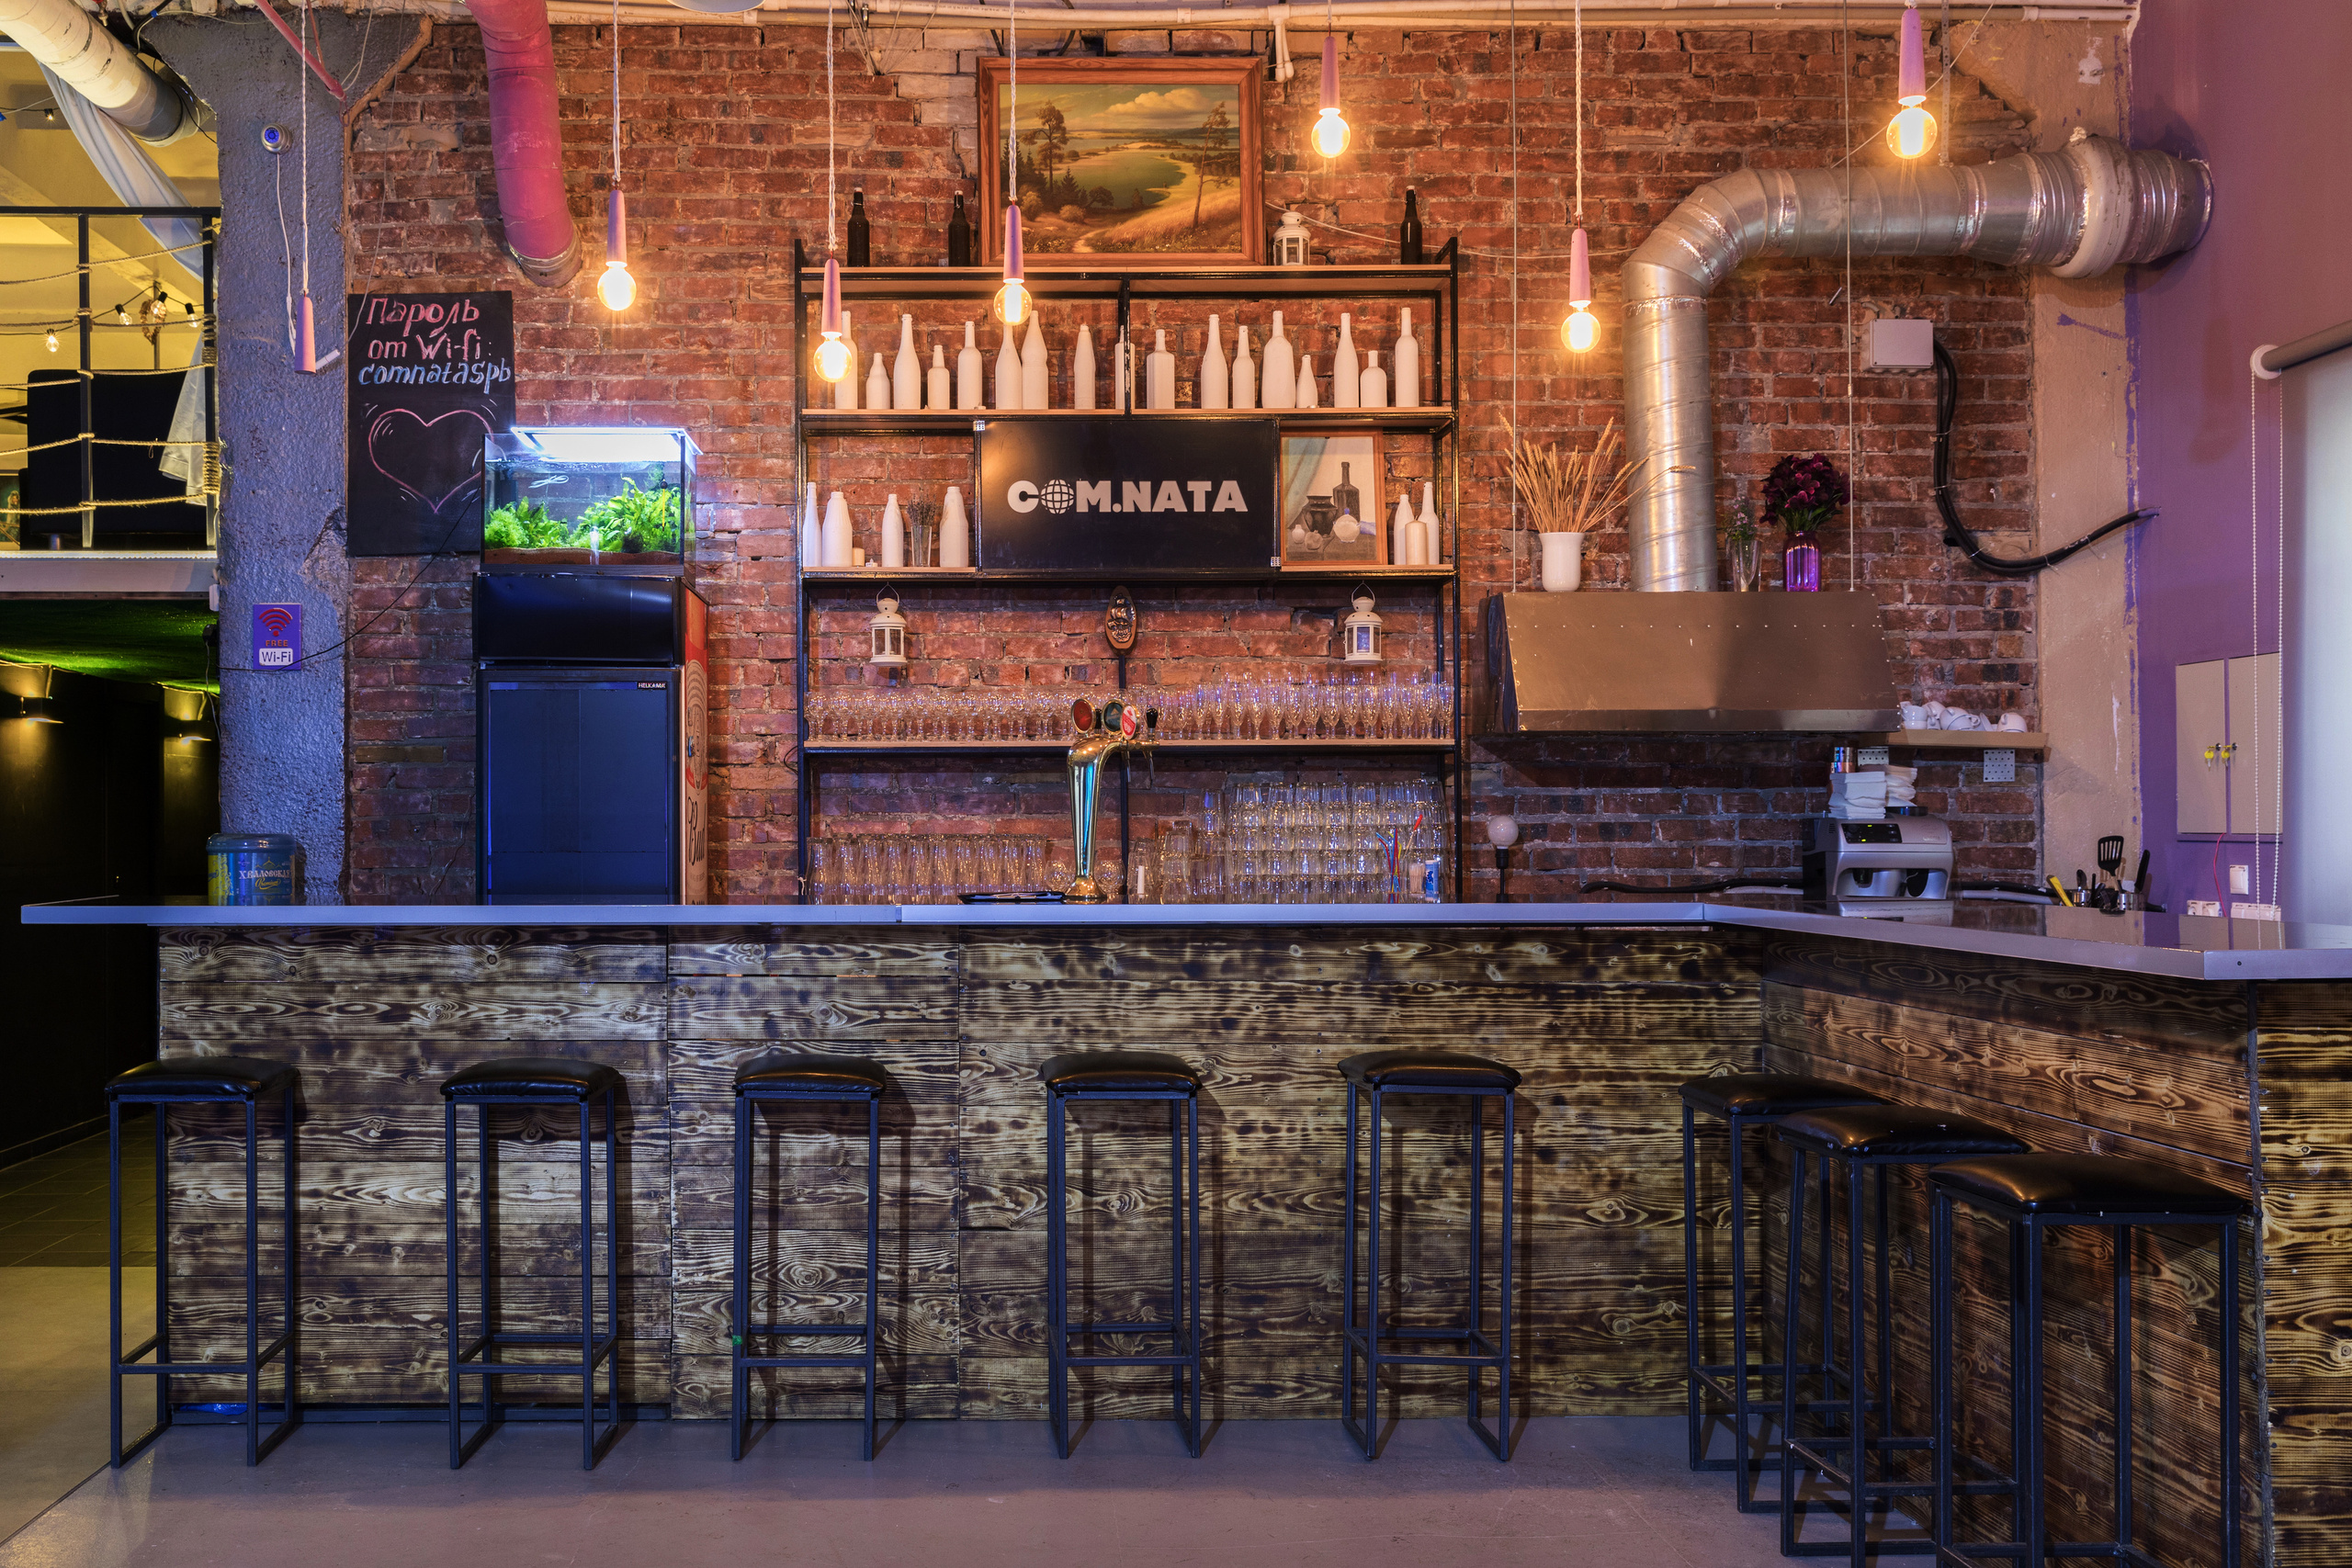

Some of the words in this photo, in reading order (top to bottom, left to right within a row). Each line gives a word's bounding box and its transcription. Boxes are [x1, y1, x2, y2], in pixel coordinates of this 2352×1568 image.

[366, 298, 480, 337] Пароль
[368, 339, 407, 359] от
[358, 358, 512, 395] comnataspb
[261, 651, 291, 662] Wi-Fi
